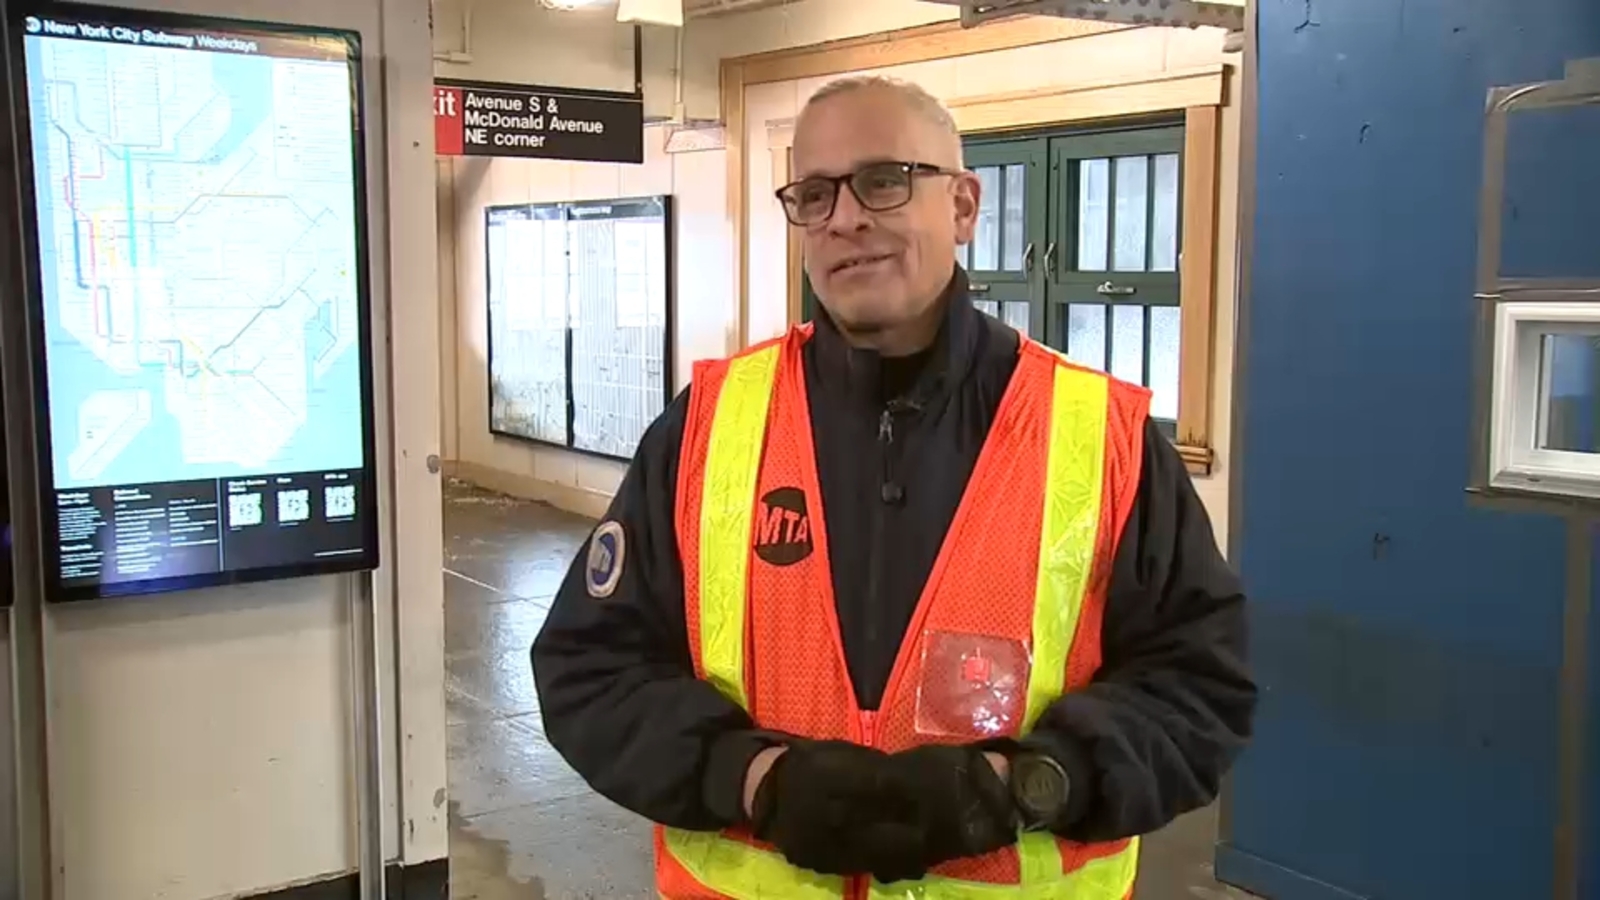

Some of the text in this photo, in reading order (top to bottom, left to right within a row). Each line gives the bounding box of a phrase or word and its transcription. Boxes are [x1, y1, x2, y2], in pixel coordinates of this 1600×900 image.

[44, 19, 258, 53] New York City Subway Weekdays
[465, 93, 559, 113] Avenue S &
[465, 111, 603, 133] McDonald Avenue
[465, 129, 545, 147] NE corner
[754, 506, 808, 545] MTA
